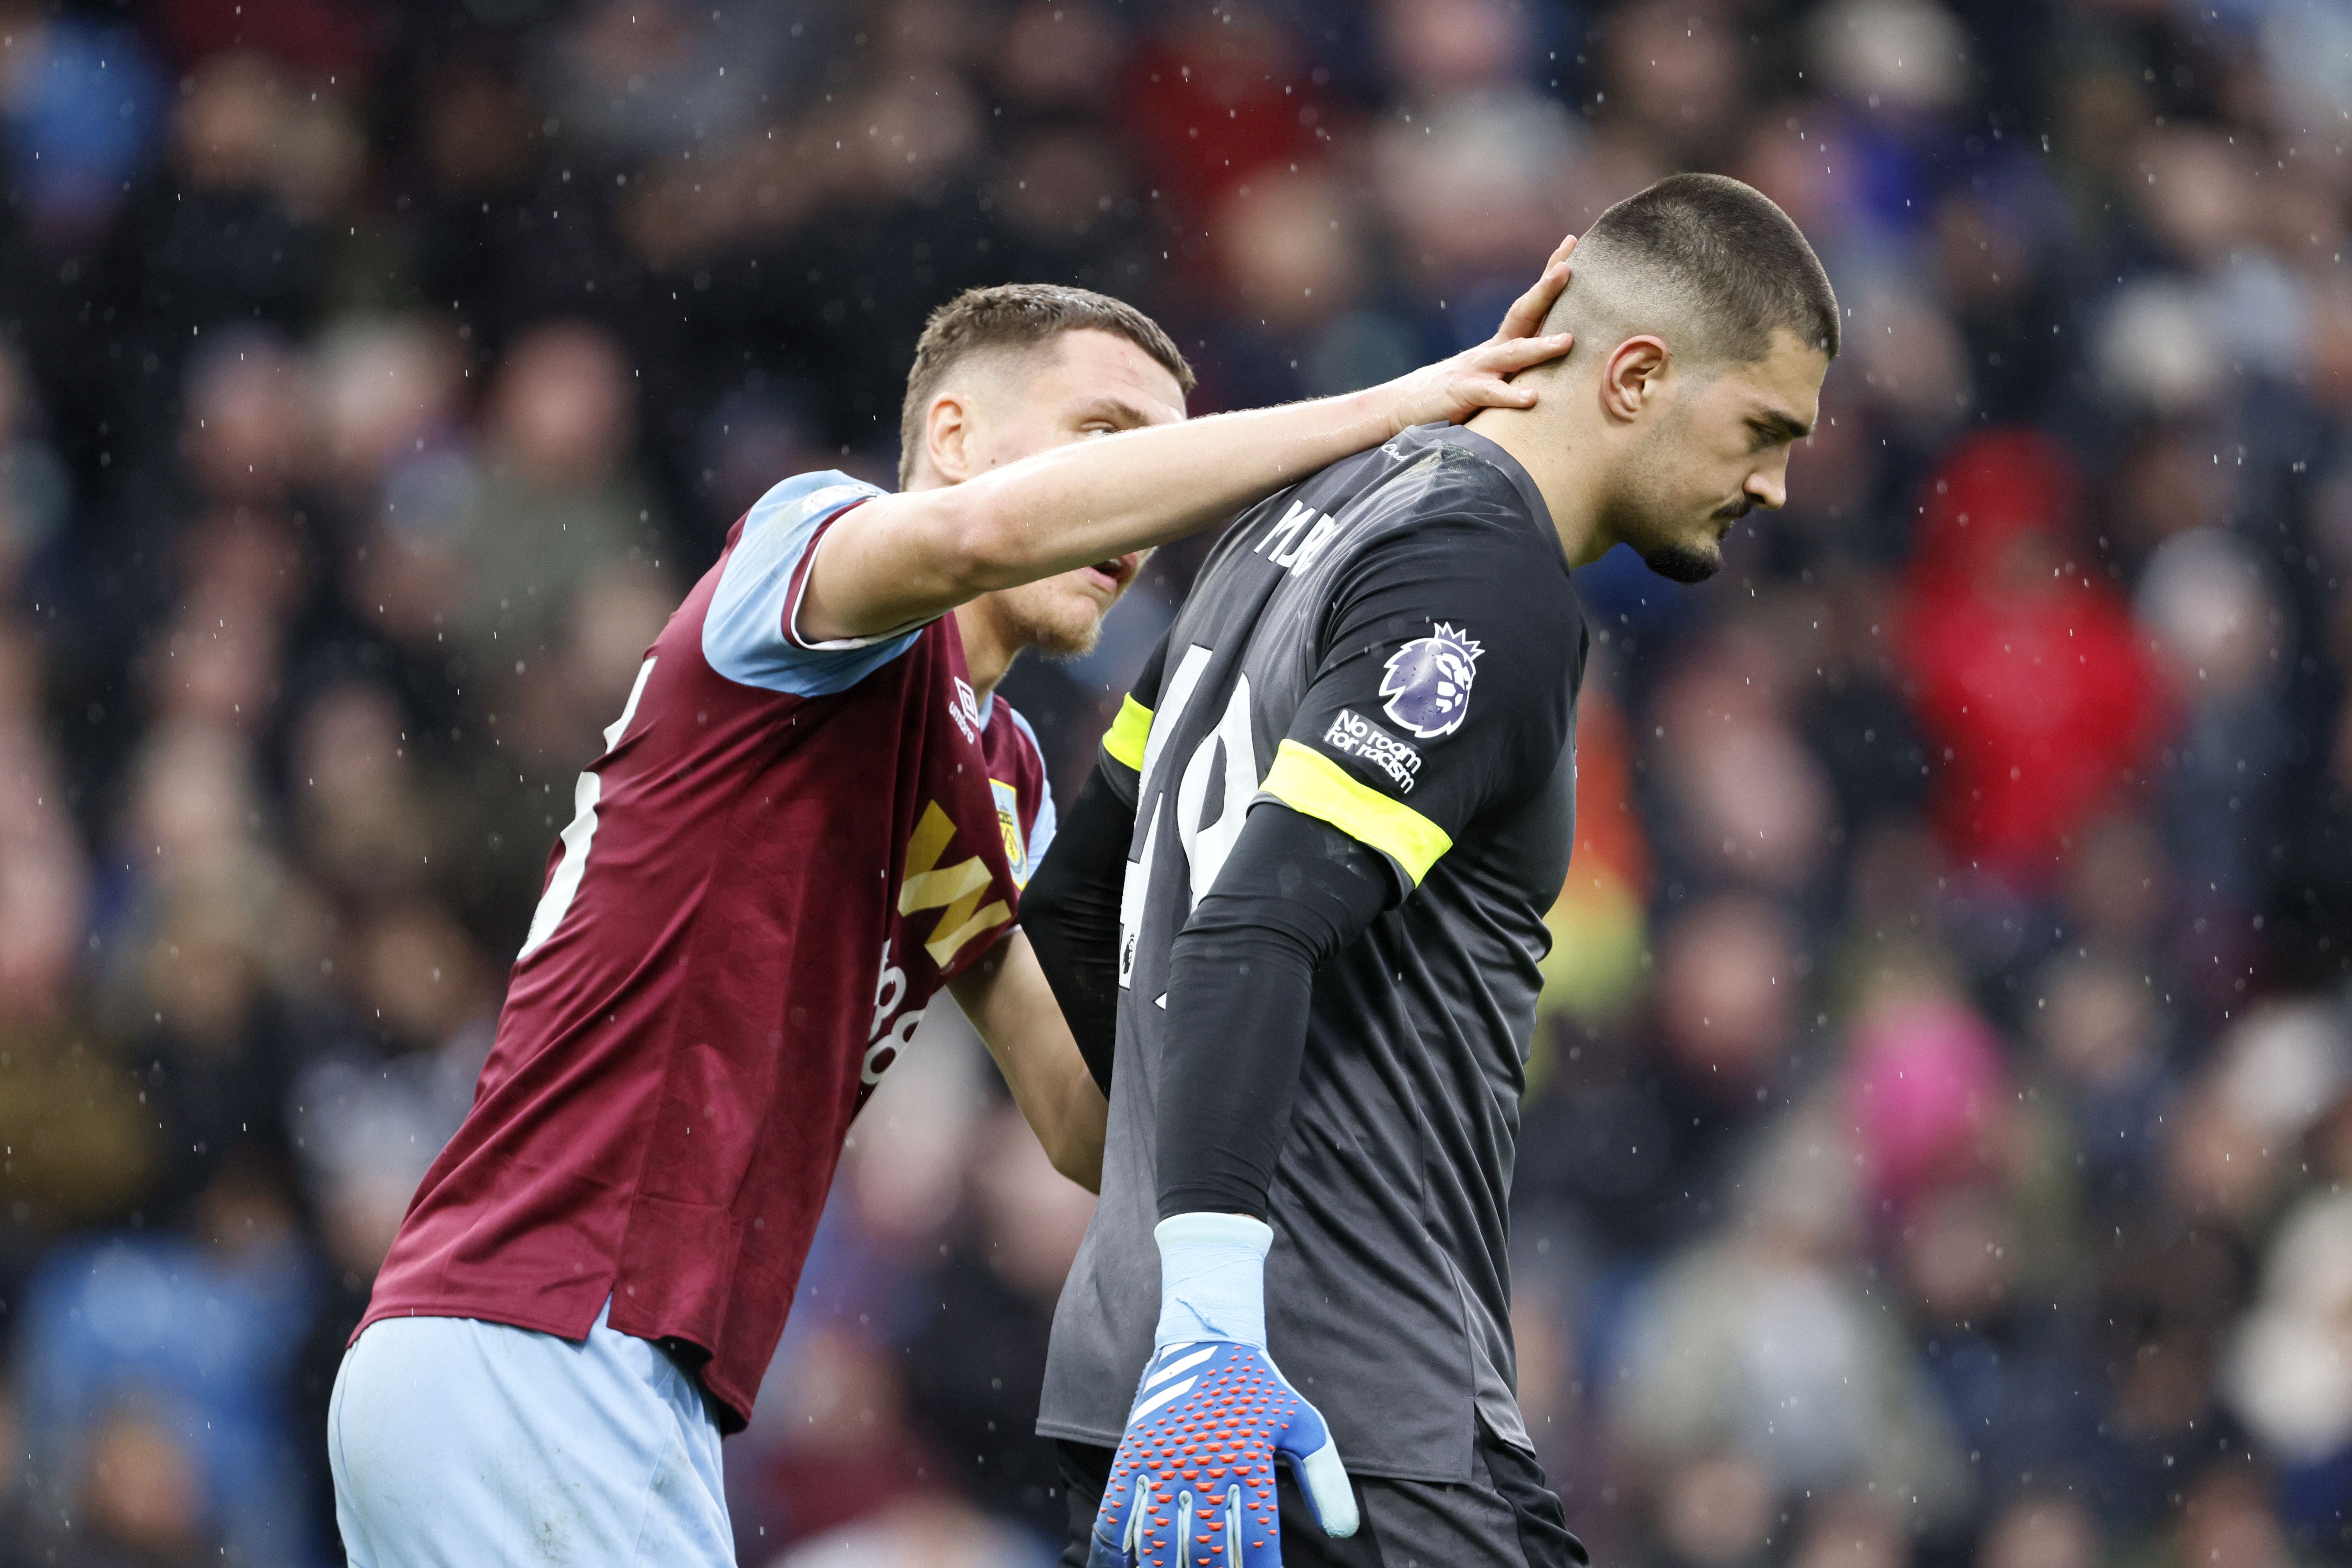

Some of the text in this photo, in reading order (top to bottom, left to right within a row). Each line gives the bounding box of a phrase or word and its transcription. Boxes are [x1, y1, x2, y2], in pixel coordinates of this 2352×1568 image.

[949, 701, 975, 744] umbro
[1334, 709, 1422, 774] No room
[1324, 726, 1415, 794] for racism
